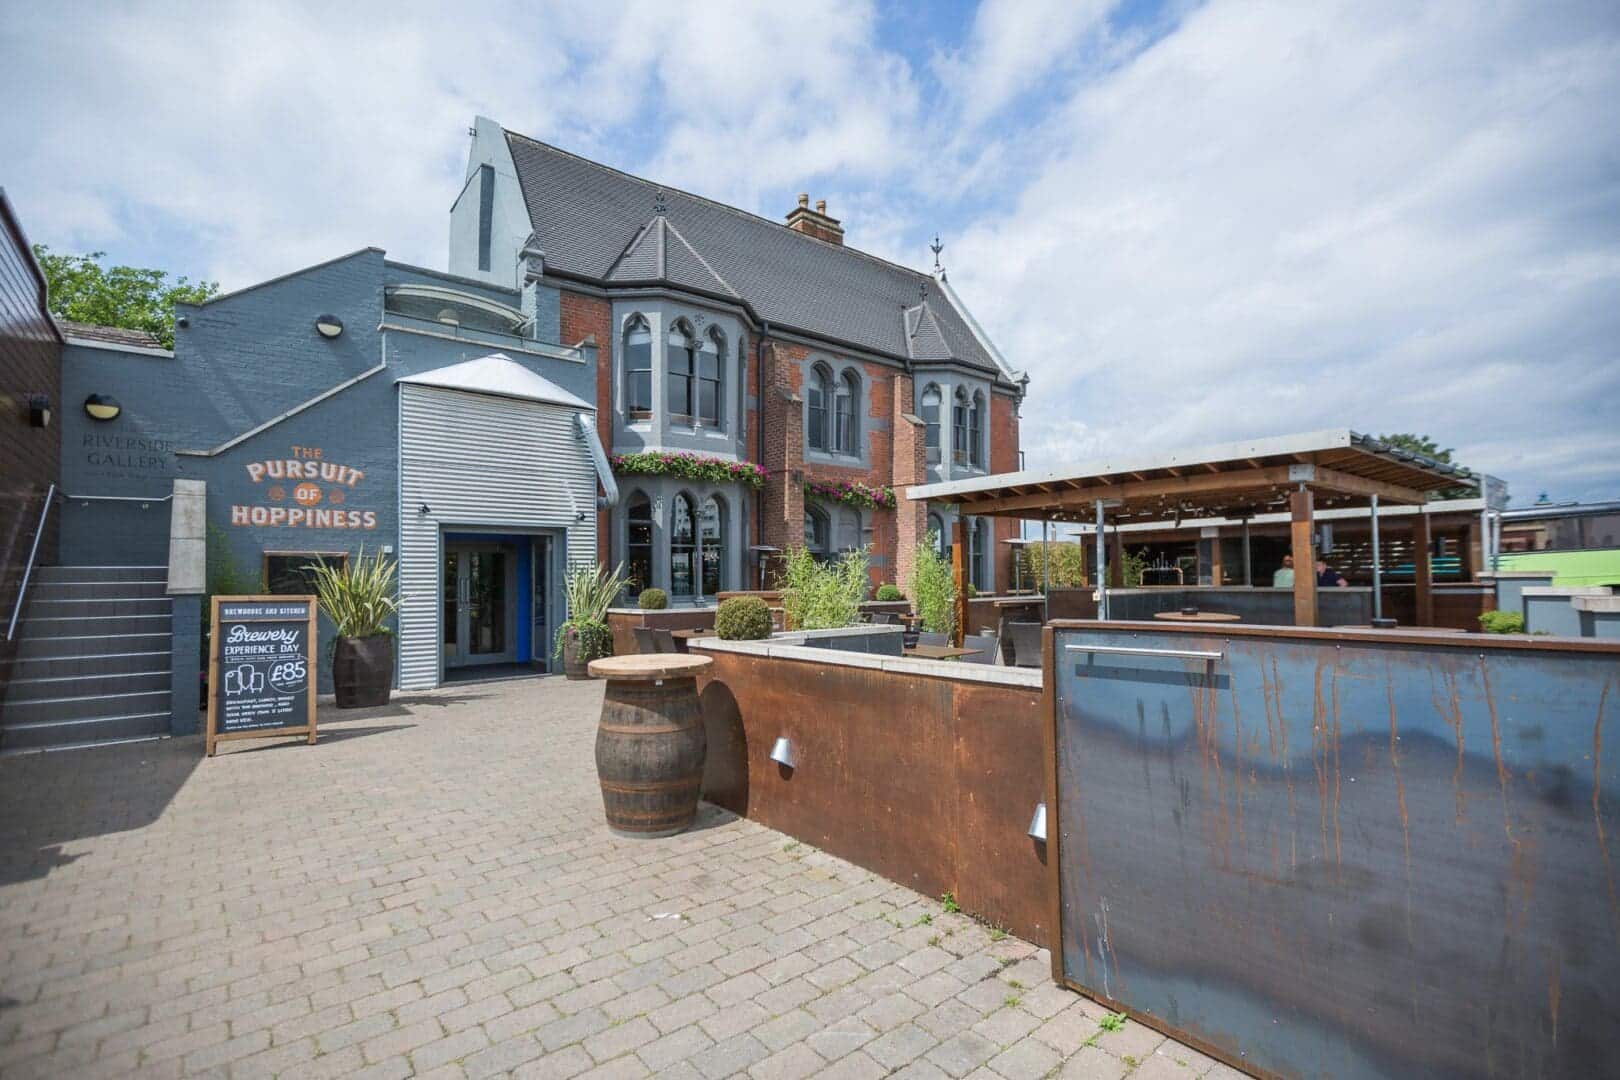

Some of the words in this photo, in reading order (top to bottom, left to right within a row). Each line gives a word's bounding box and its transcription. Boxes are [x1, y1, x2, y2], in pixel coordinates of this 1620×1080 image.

[290, 445, 323, 458] THE
[87, 452, 169, 470] GALLERY
[246, 459, 364, 487] PURSUIT
[296, 486, 319, 501] OF
[231, 504, 377, 529] HOPPINESS
[227, 625, 299, 644] Brewery
[225, 645, 276, 656] EXPERIENCE
[280, 644, 300, 653] DAY
[271, 661, 306, 681] £85
